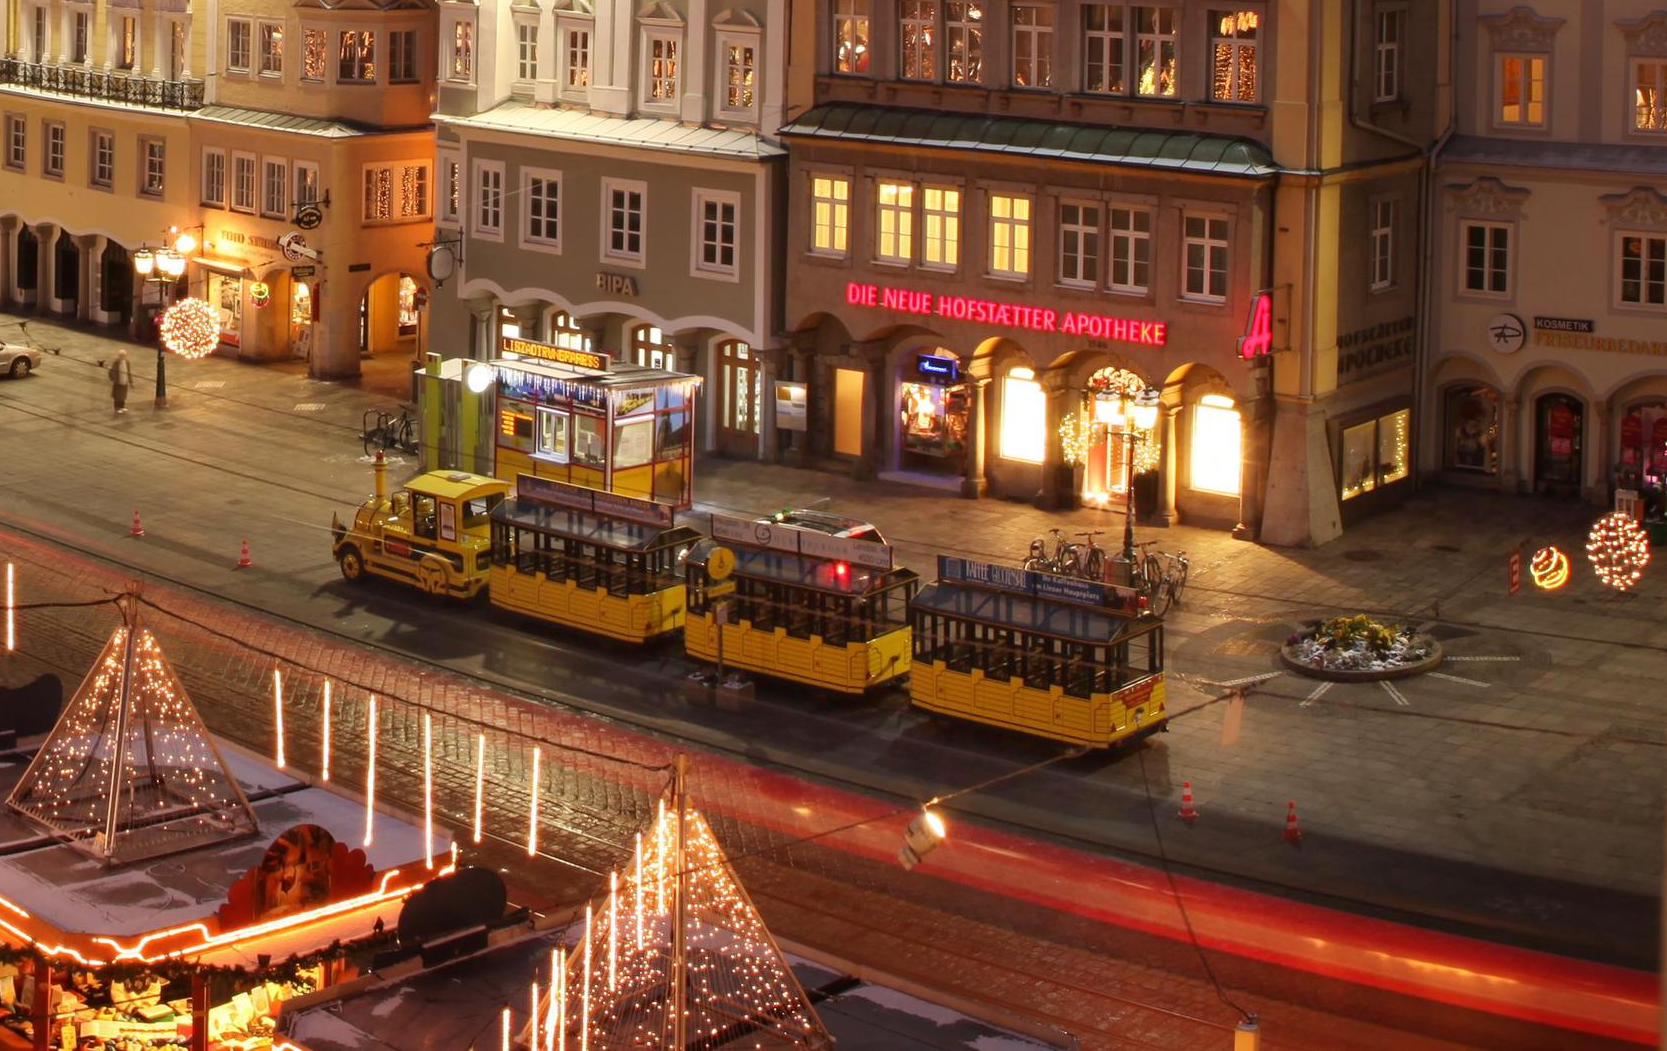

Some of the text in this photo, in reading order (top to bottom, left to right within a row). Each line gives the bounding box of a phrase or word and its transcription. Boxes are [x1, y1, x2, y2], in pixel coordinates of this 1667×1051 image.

[847, 283, 878, 306] DIE
[883, 288, 932, 314] NEUE
[1062, 312, 1166, 345] APOTHEKE
[1537, 319, 1589, 331] KOSMETIK
